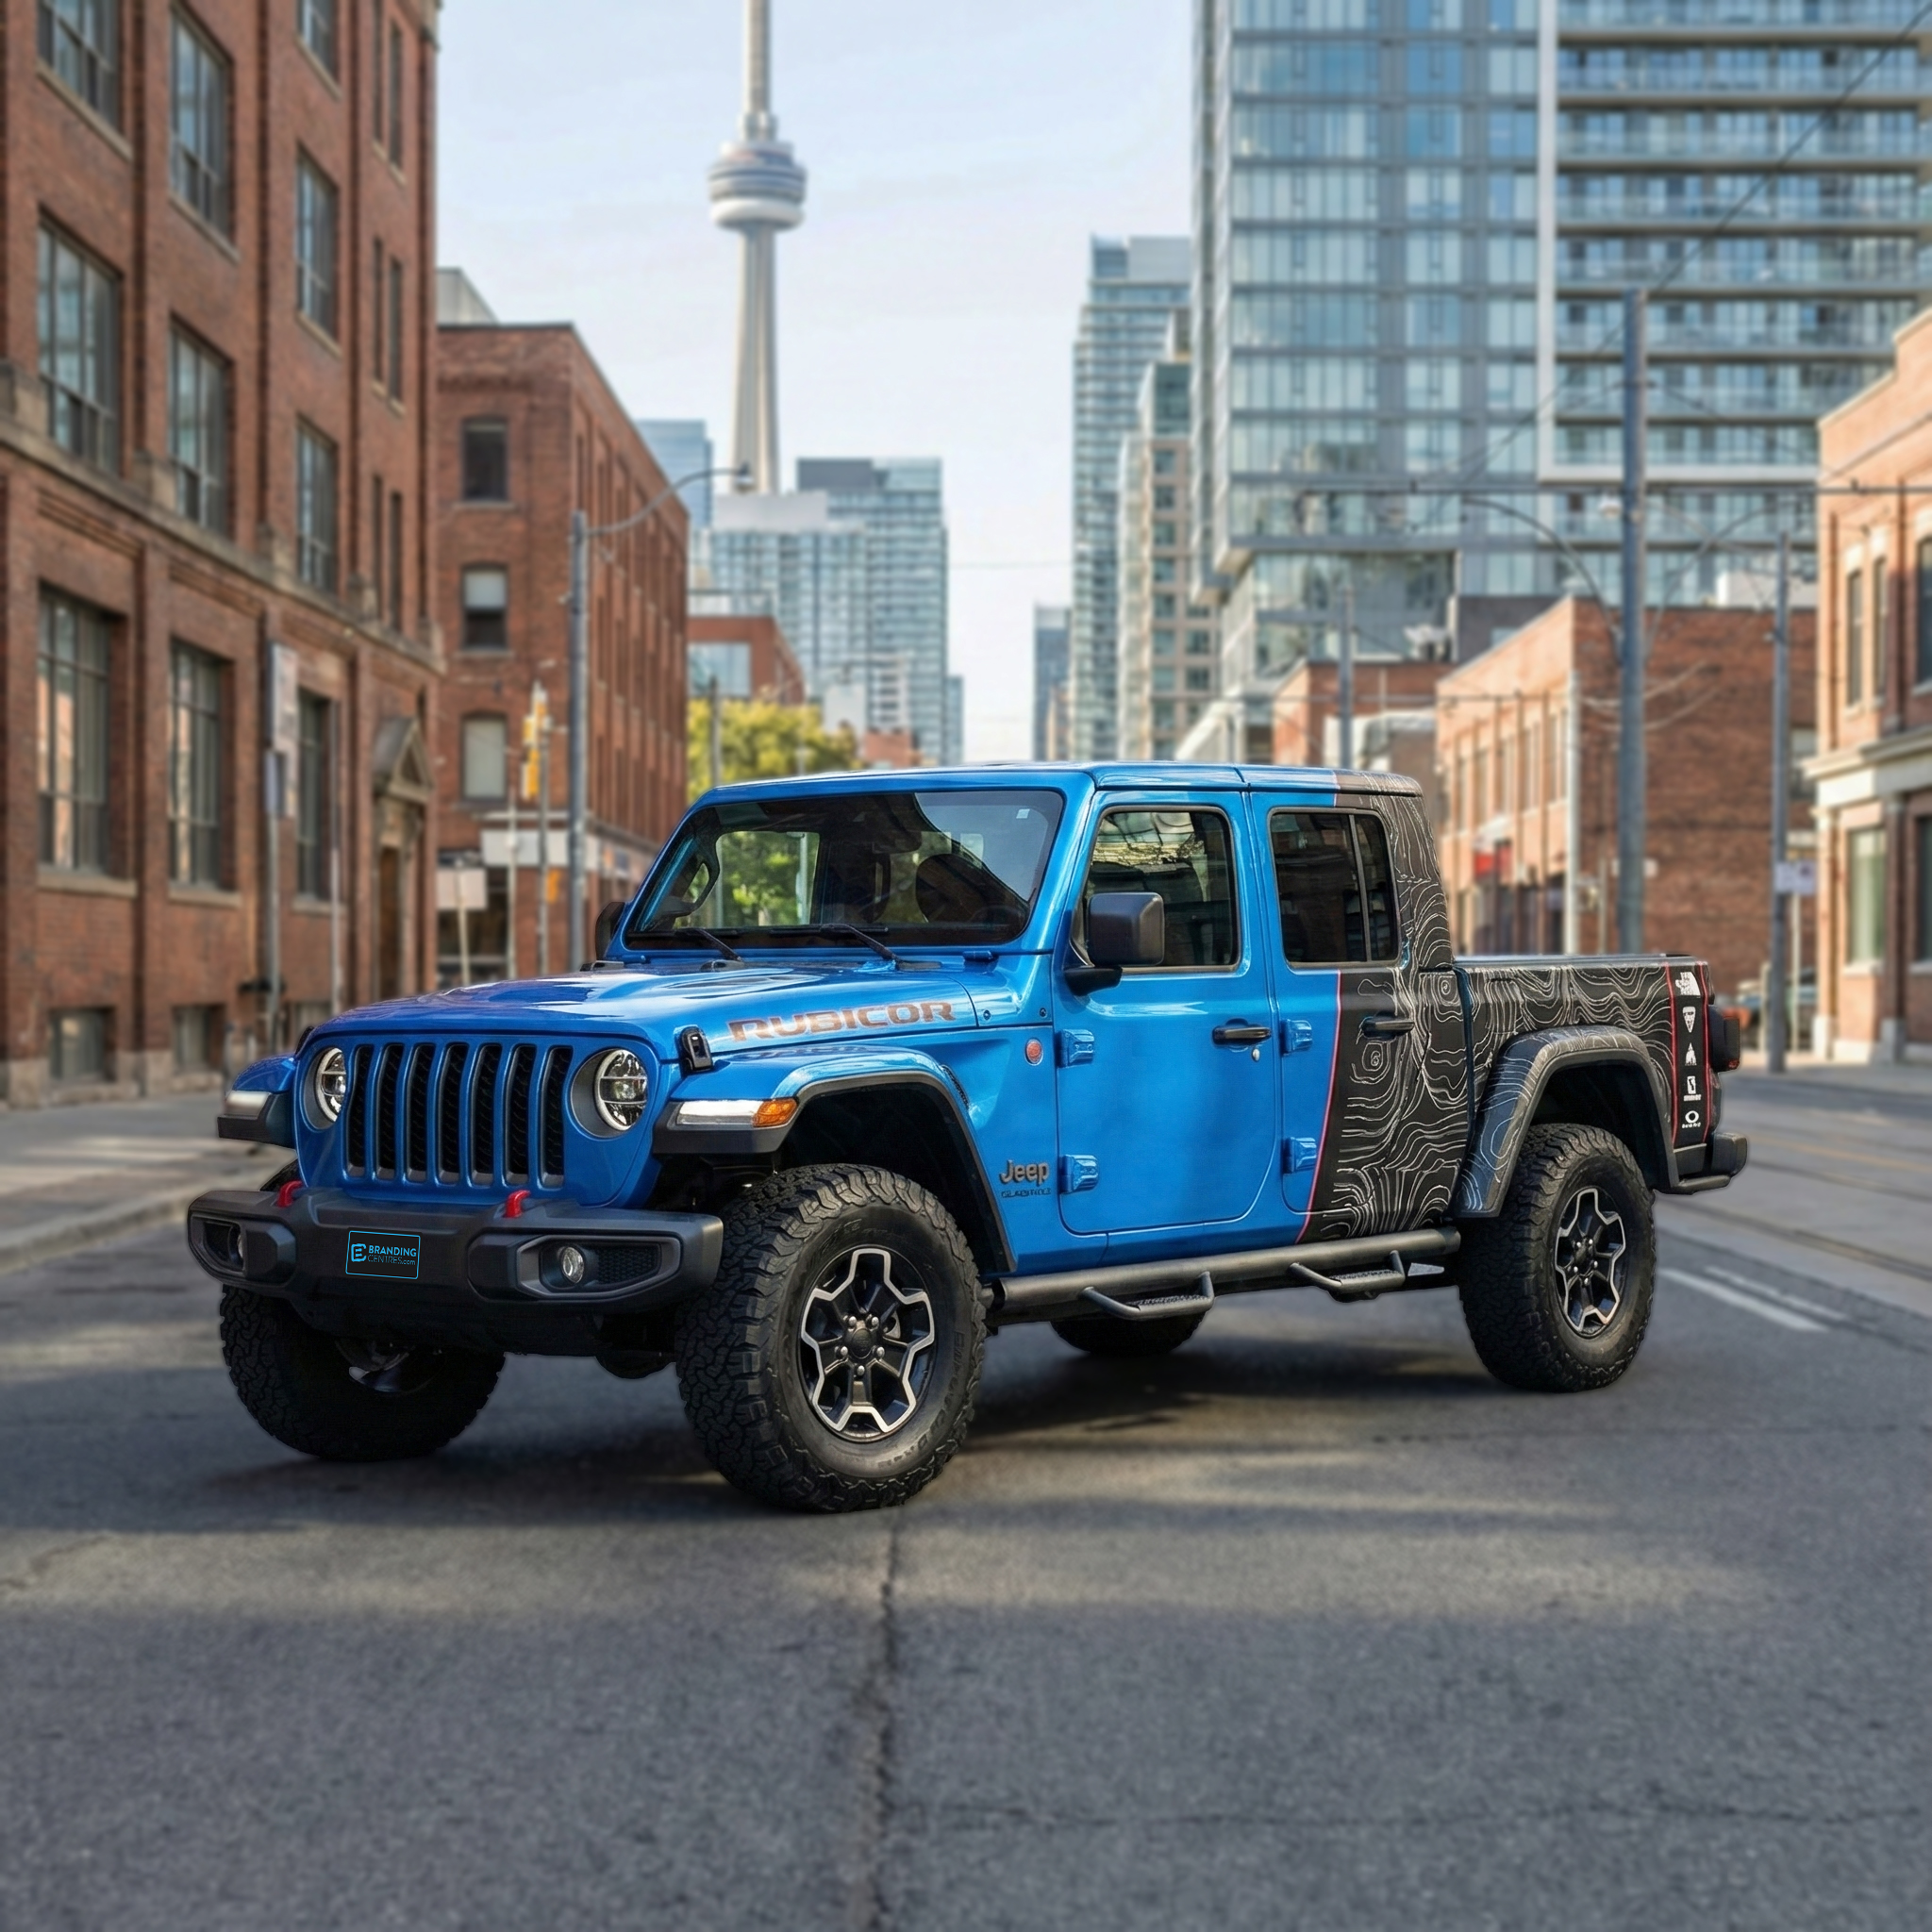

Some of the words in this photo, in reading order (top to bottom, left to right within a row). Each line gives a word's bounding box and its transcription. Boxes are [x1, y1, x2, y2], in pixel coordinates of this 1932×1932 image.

[728, 1001, 956, 1042] RUBICOR
[1000, 1159, 1049, 1187] Jeep
[367, 1254, 416, 1266] CENTRES.com
[368, 1244, 417, 1257] BRANDING
